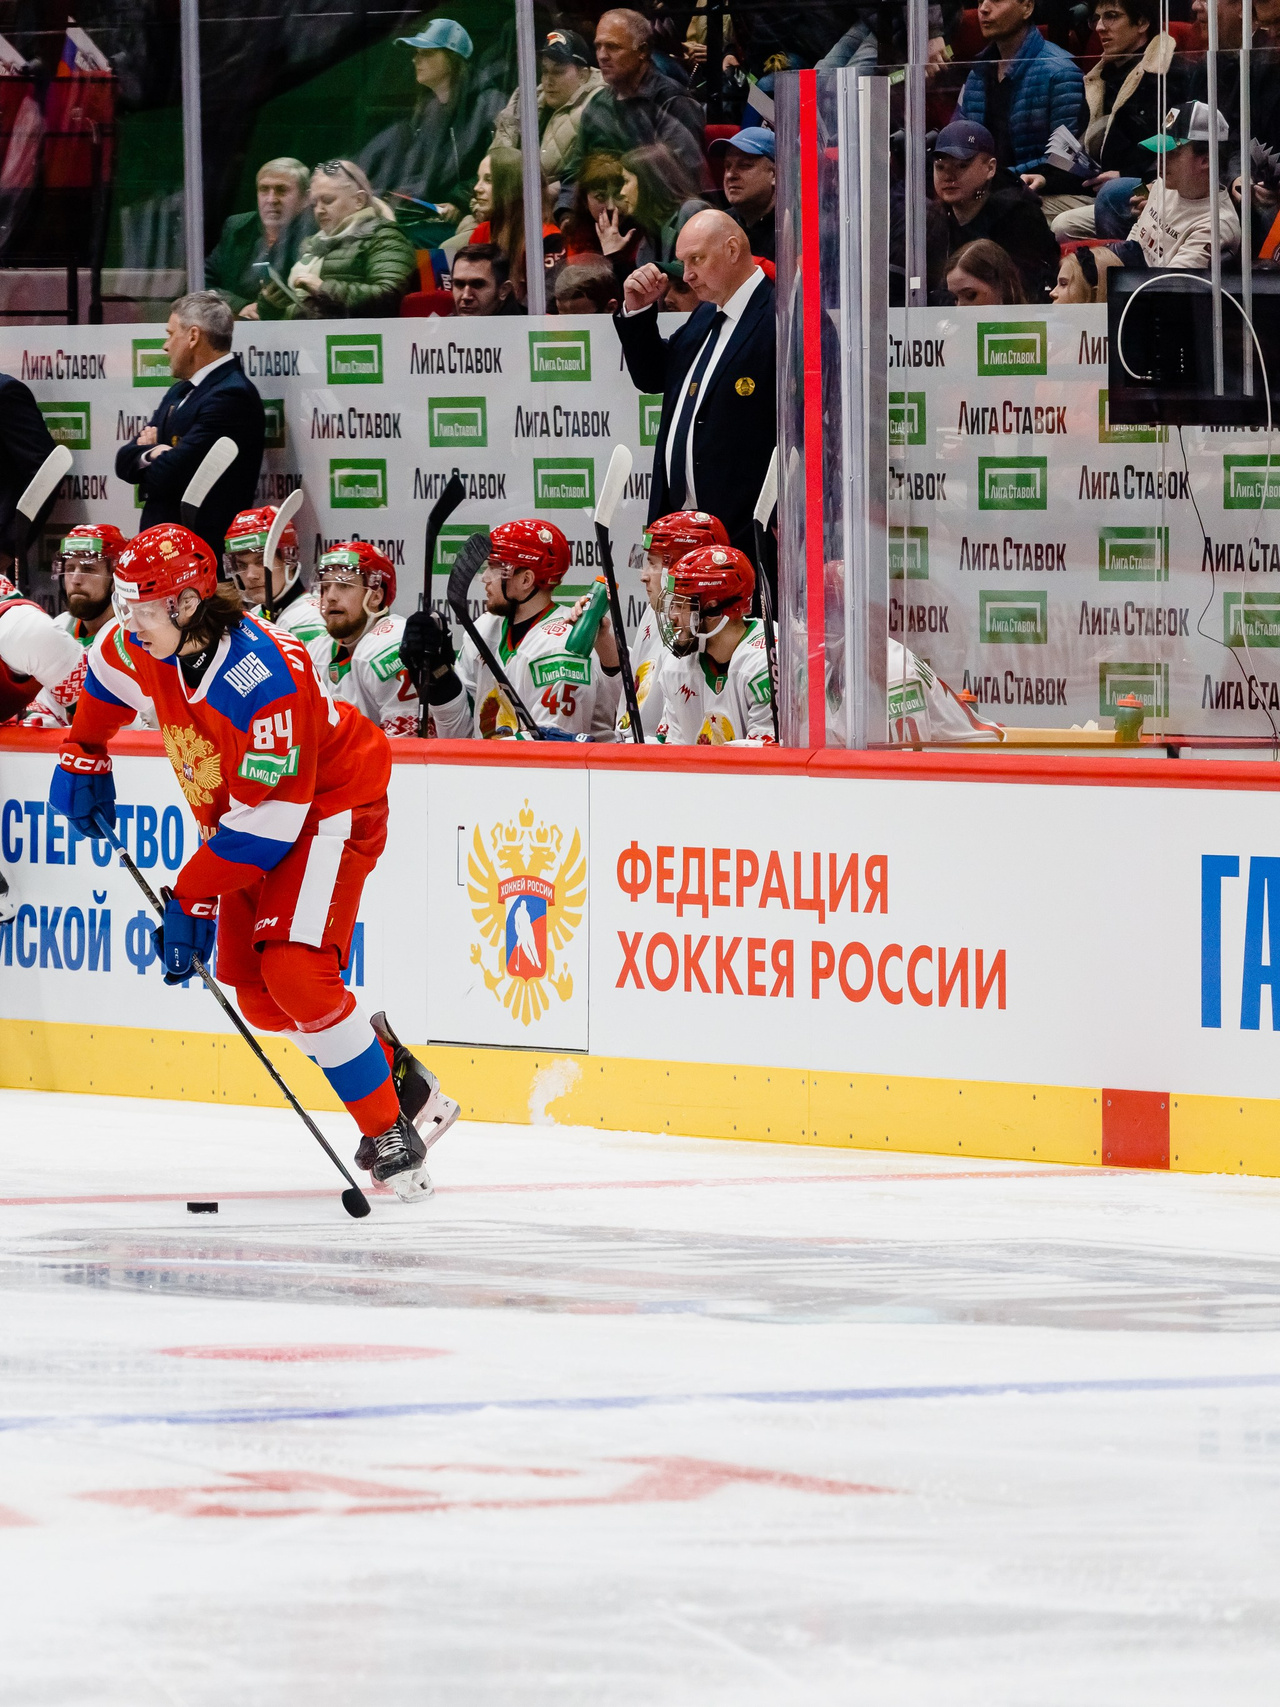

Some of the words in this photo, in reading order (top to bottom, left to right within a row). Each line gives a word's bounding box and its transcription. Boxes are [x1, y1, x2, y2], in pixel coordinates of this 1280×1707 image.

[410, 342, 446, 375] ЛИГА
[448, 342, 503, 374] СТАВОК
[1078, 330, 1108, 365] ЛИГ
[311, 407, 345, 439] ЛИГА
[348, 407, 402, 439] СТАВОК
[515, 405, 551, 438] ЛИГА
[553, 405, 611, 437] СТАВОК
[958, 401, 999, 435] ЛИГА
[1002, 400, 1067, 435] СТАВОК
[452, 467, 506, 499] ТАВОК
[1079, 465, 1120, 500] ЛИГА
[1123, 465, 1190, 500] СТАВОК
[517, 553, 540, 561] CCM
[959, 537, 1000, 571] ЛИГА
[1003, 537, 1067, 571] СТАВОК
[176, 569, 198, 585] CCM
[1079, 600, 1120, 636] ЛИГА
[1124, 601, 1190, 636] СТАВОК
[192, 652, 208, 669] CCM
[541, 669, 560, 683] ЛИГА
[560, 667, 585, 680] СТАВОК
[397, 671, 418, 702] 2
[541, 684, 579, 716] 45
[1004, 670, 1067, 706] СТАВОК
[252, 708, 293, 750] 84
[60, 751, 113, 773] CCM
[248, 765, 269, 784] ЛИГА
[501, 877, 525, 897] ХОККЕЙ
[527, 880, 553, 899] РОССИИ
[616, 840, 888, 924] ФЕДЕРАЦИЯ
[1201, 854, 1280, 1032] ГА
[615, 931, 794, 998] ХОККЕЯ
[811, 941, 1007, 1010] РОССИИ
